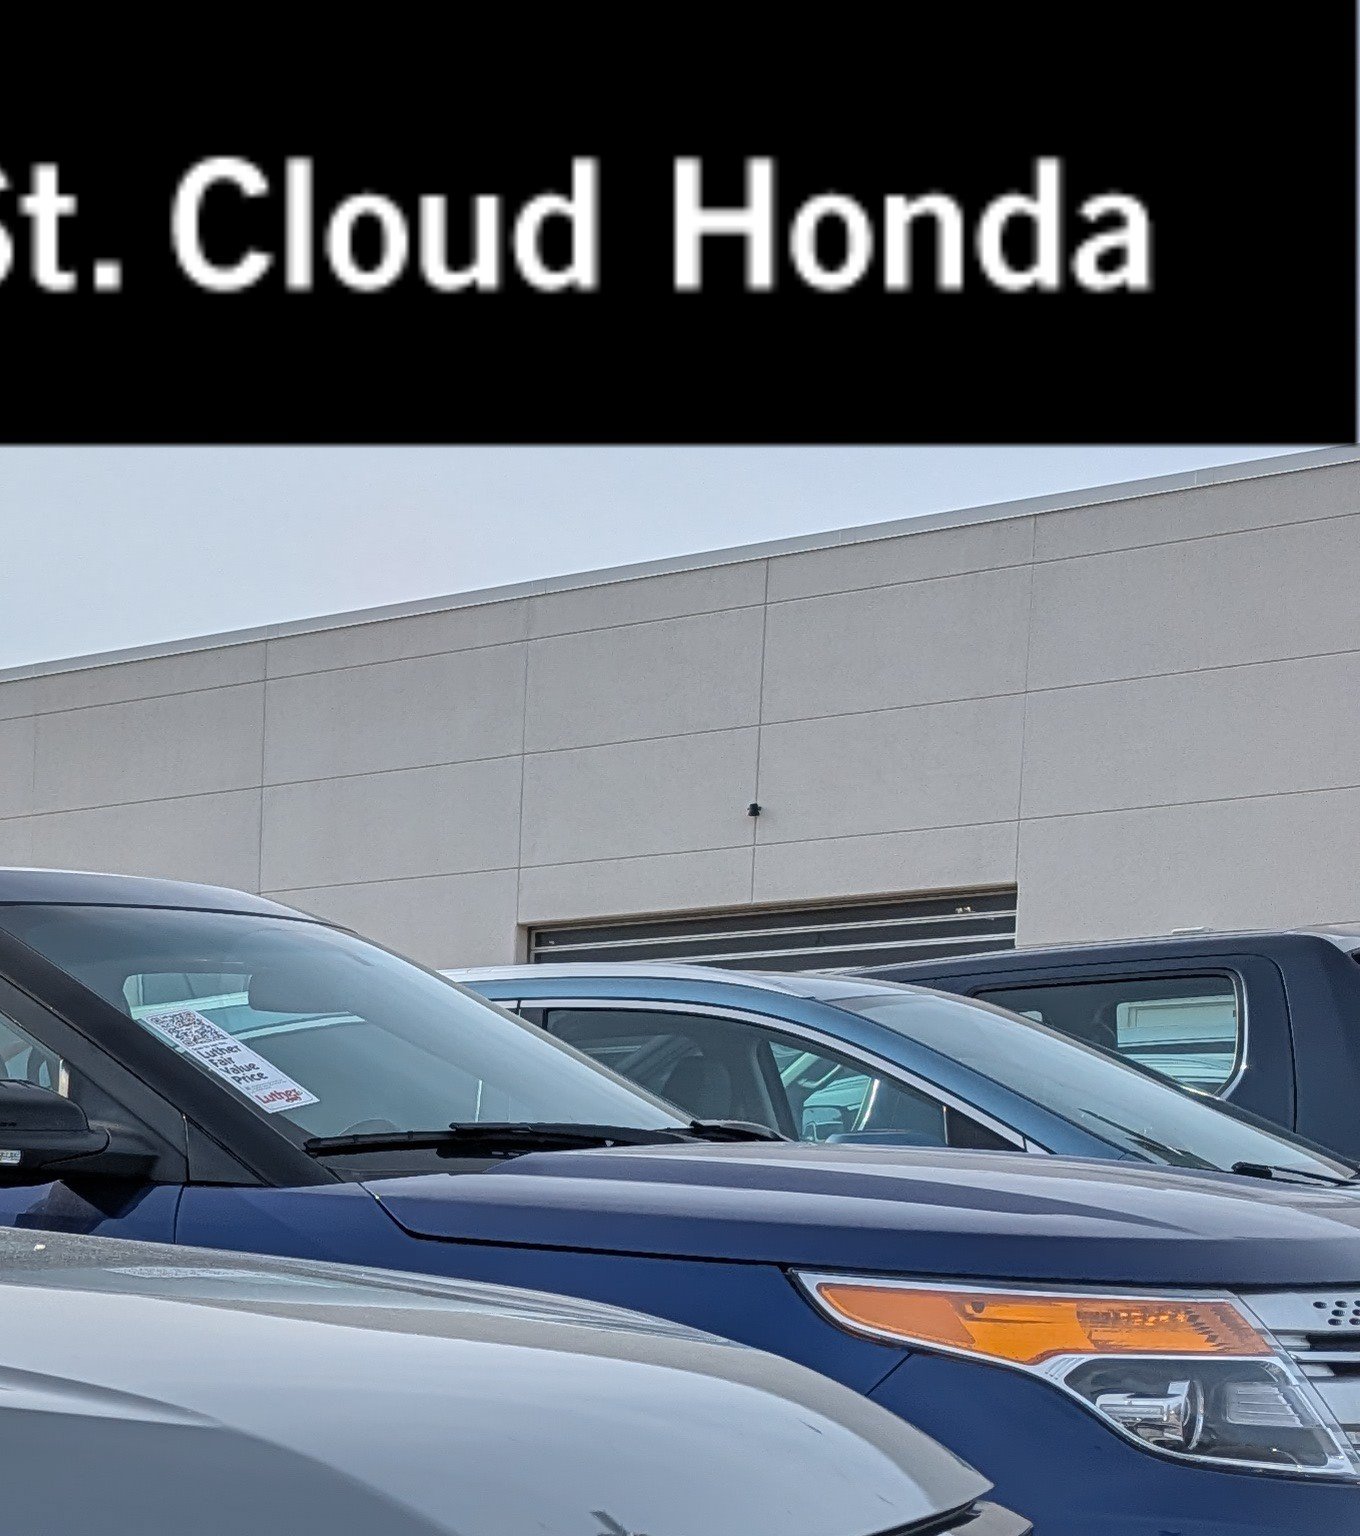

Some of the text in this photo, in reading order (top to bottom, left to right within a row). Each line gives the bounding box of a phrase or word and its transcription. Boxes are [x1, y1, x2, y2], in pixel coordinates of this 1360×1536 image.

[196, 1044, 242, 1059] Luther
[207, 1055, 236, 1068] Fair
[219, 1062, 261, 1075] Value
[230, 1071, 269, 1085] Price
[255, 1088, 303, 1104] Luther
